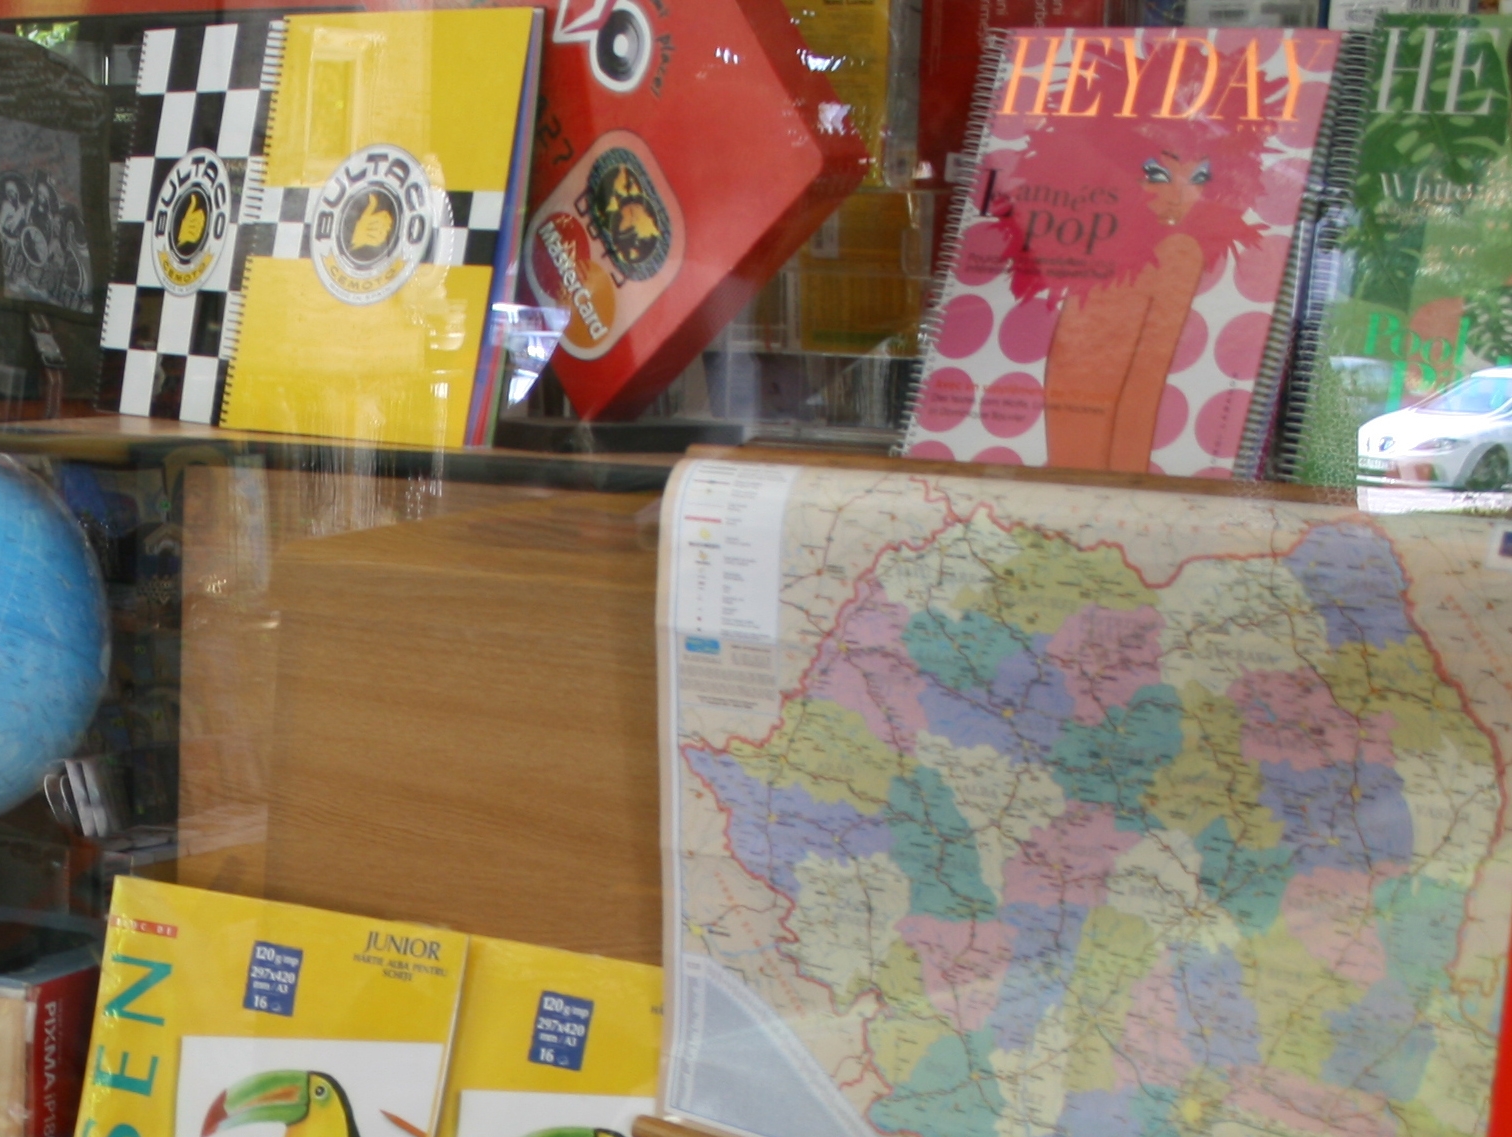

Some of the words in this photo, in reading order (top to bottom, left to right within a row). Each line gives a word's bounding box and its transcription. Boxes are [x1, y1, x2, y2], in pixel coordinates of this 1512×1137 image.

[996, 35, 1335, 123] HEYDAY
[154, 155, 227, 240] BULTACO
[314, 152, 426, 245] BULTACO
[1023, 207, 1119, 256] pop
[537, 221, 609, 342] MasterCard
[364, 931, 443, 961] JUNIOR
[253, 994, 268, 1009] 16
[43, 1001, 57, 1090] PIXMA
[540, 1047, 555, 1063] 16
